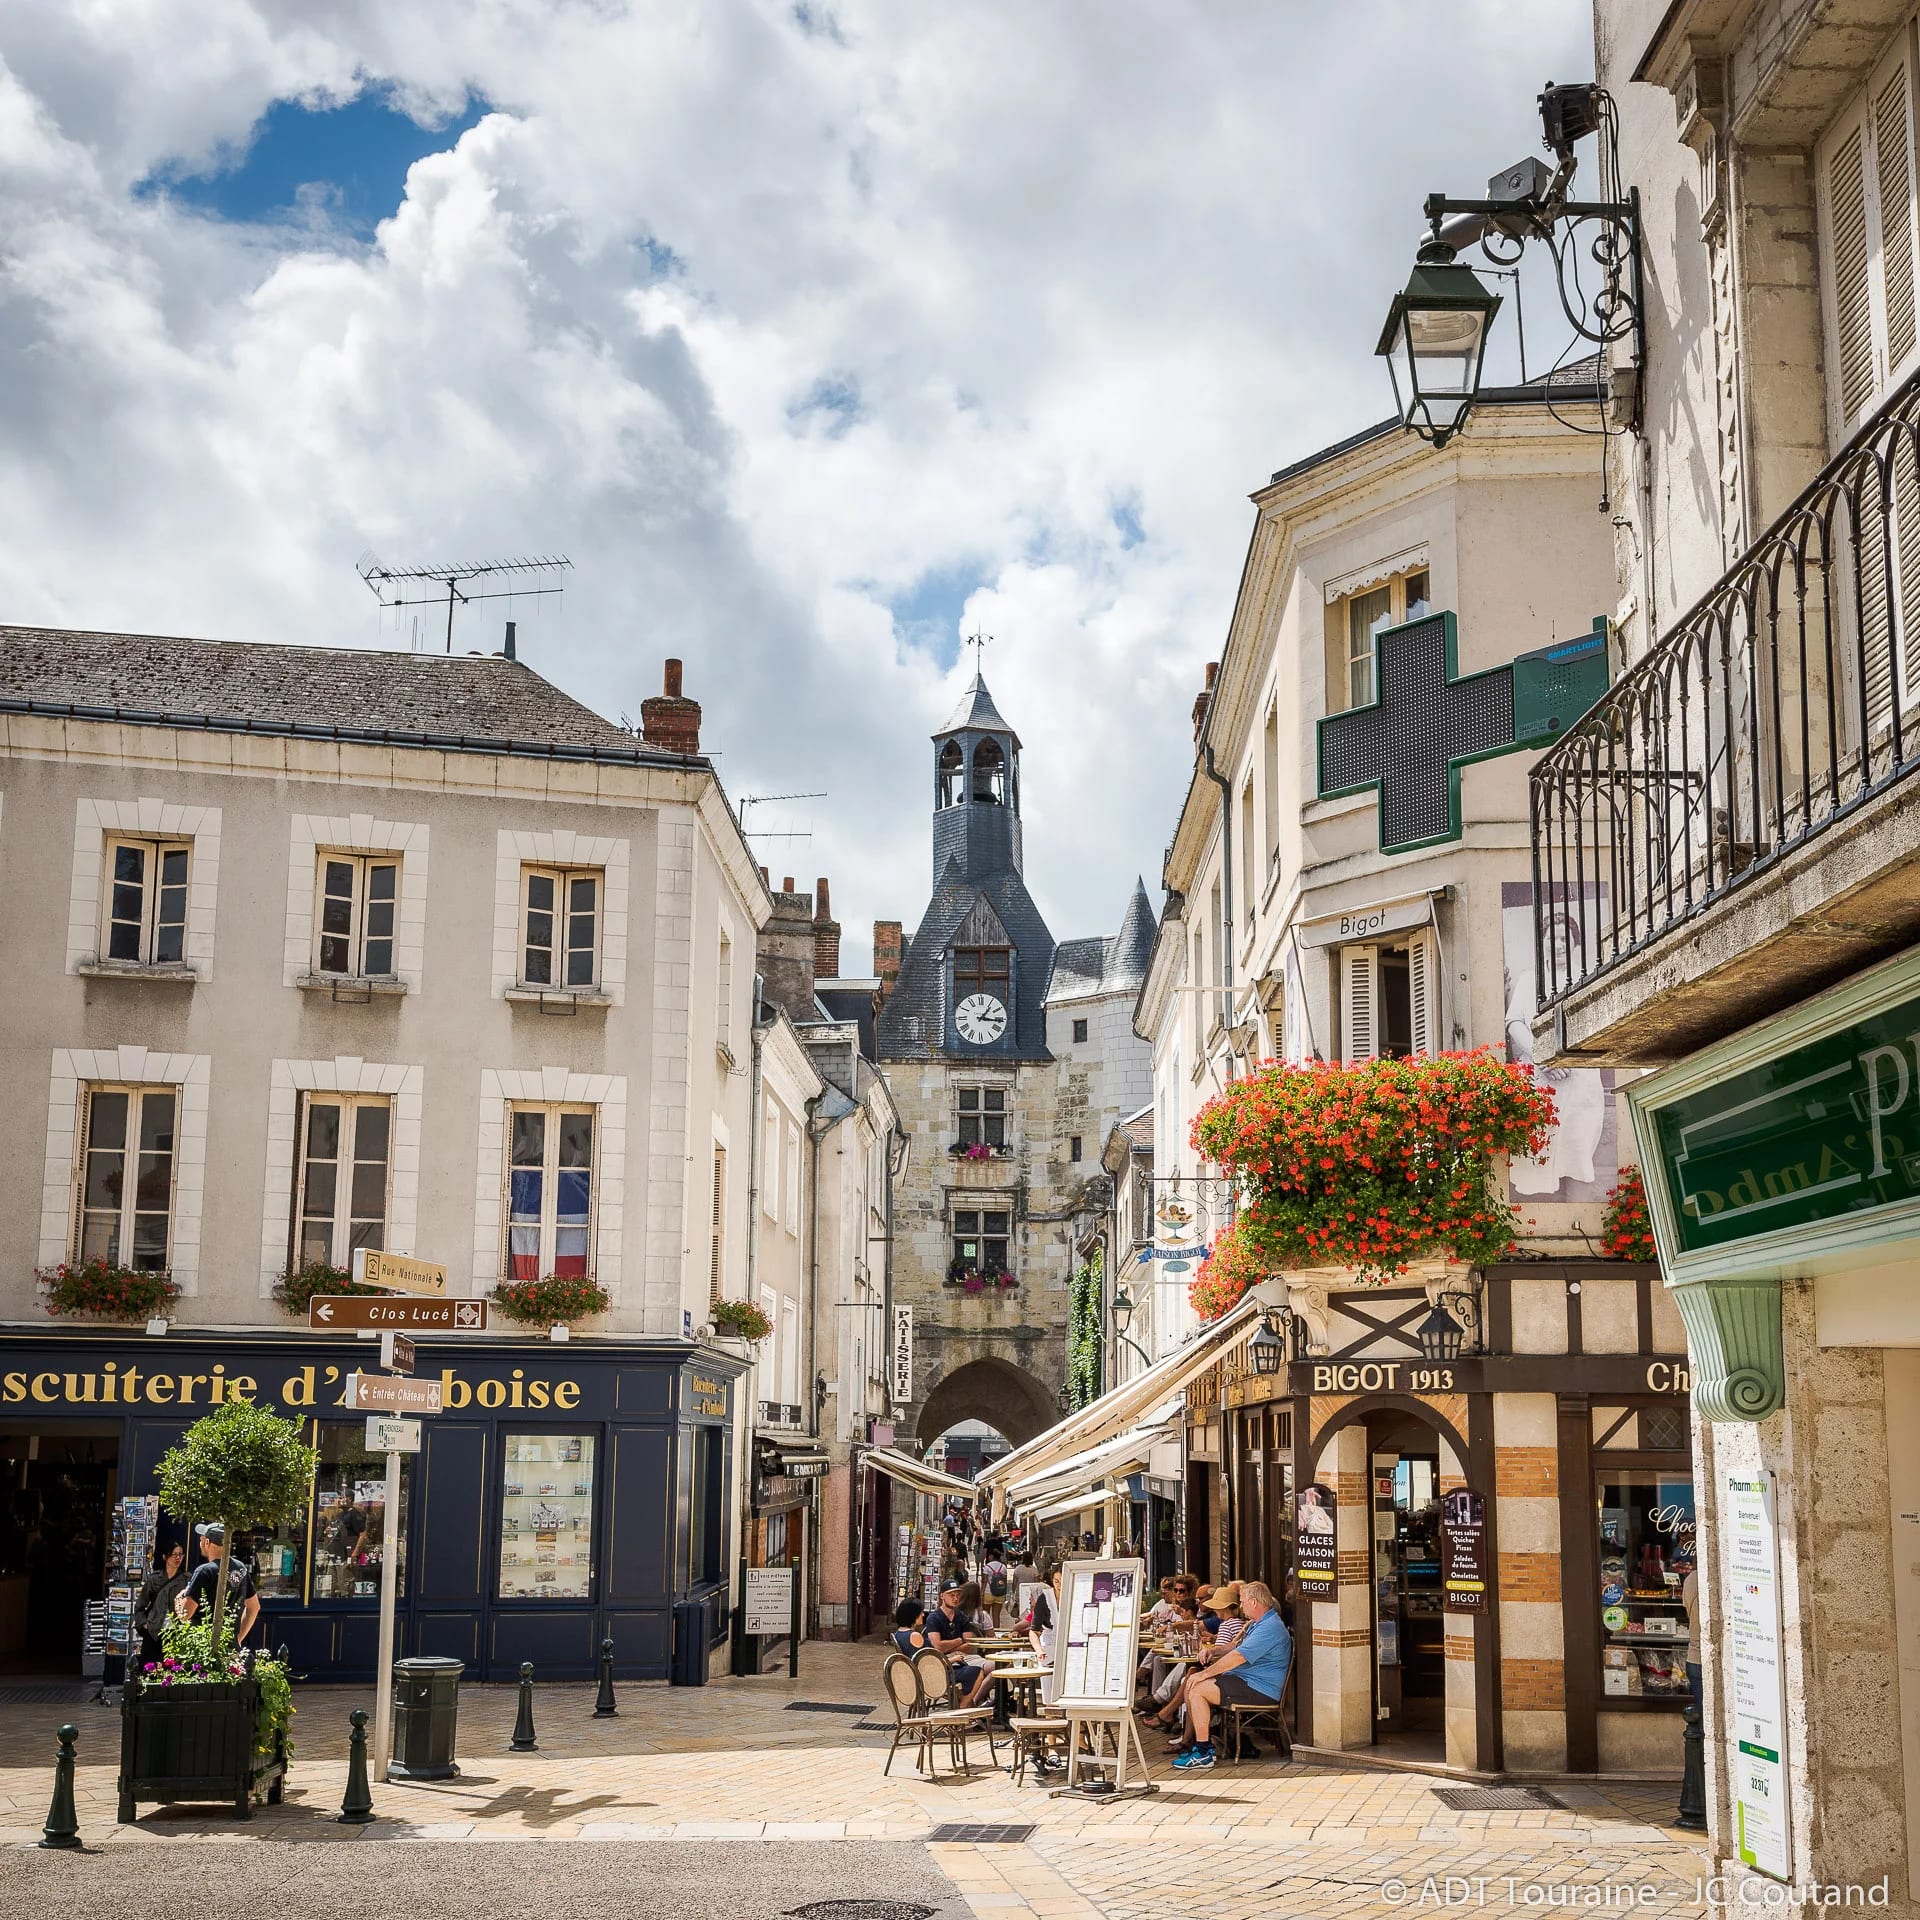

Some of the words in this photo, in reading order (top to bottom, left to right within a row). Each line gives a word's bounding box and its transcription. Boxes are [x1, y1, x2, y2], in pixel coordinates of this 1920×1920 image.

[1546, 636, 1604, 661] SMARTLIGHT
[1340, 908, 1386, 936] Bigot
[381, 1264, 396, 1276] Rue
[399, 1268, 433, 1284] Nationale
[369, 1307, 406, 1320] Clos
[412, 1307, 449, 1320] Lucé
[897, 1310, 910, 1397] PATISSERIE
[1314, 1364, 1401, 1391] BIGOT
[1410, 1369, 1454, 1390] 1913
[282, 1366, 580, 1409] d'boise
[372, 1386, 395, 1400] Entrée
[397, 1388, 426, 1402] Château
[1729, 1478, 1768, 1493] Pharmactiv
[1447, 1528, 1463, 1536] Tartes
[1464, 1529, 1480, 1537] salées
[1299, 1535, 1334, 1546] GLACES
[1452, 1536, 1475, 1544] Quiches
[1298, 1547, 1335, 1558] MAISON
[1455, 1544, 1472, 1552] Pizzas
[1302, 1560, 1331, 1569] CORNET
[1450, 1571, 1479, 1580] Omelettes
[1302, 1581, 1330, 1592] BIGOT
[1450, 1592, 1481, 1603] BIGOT
